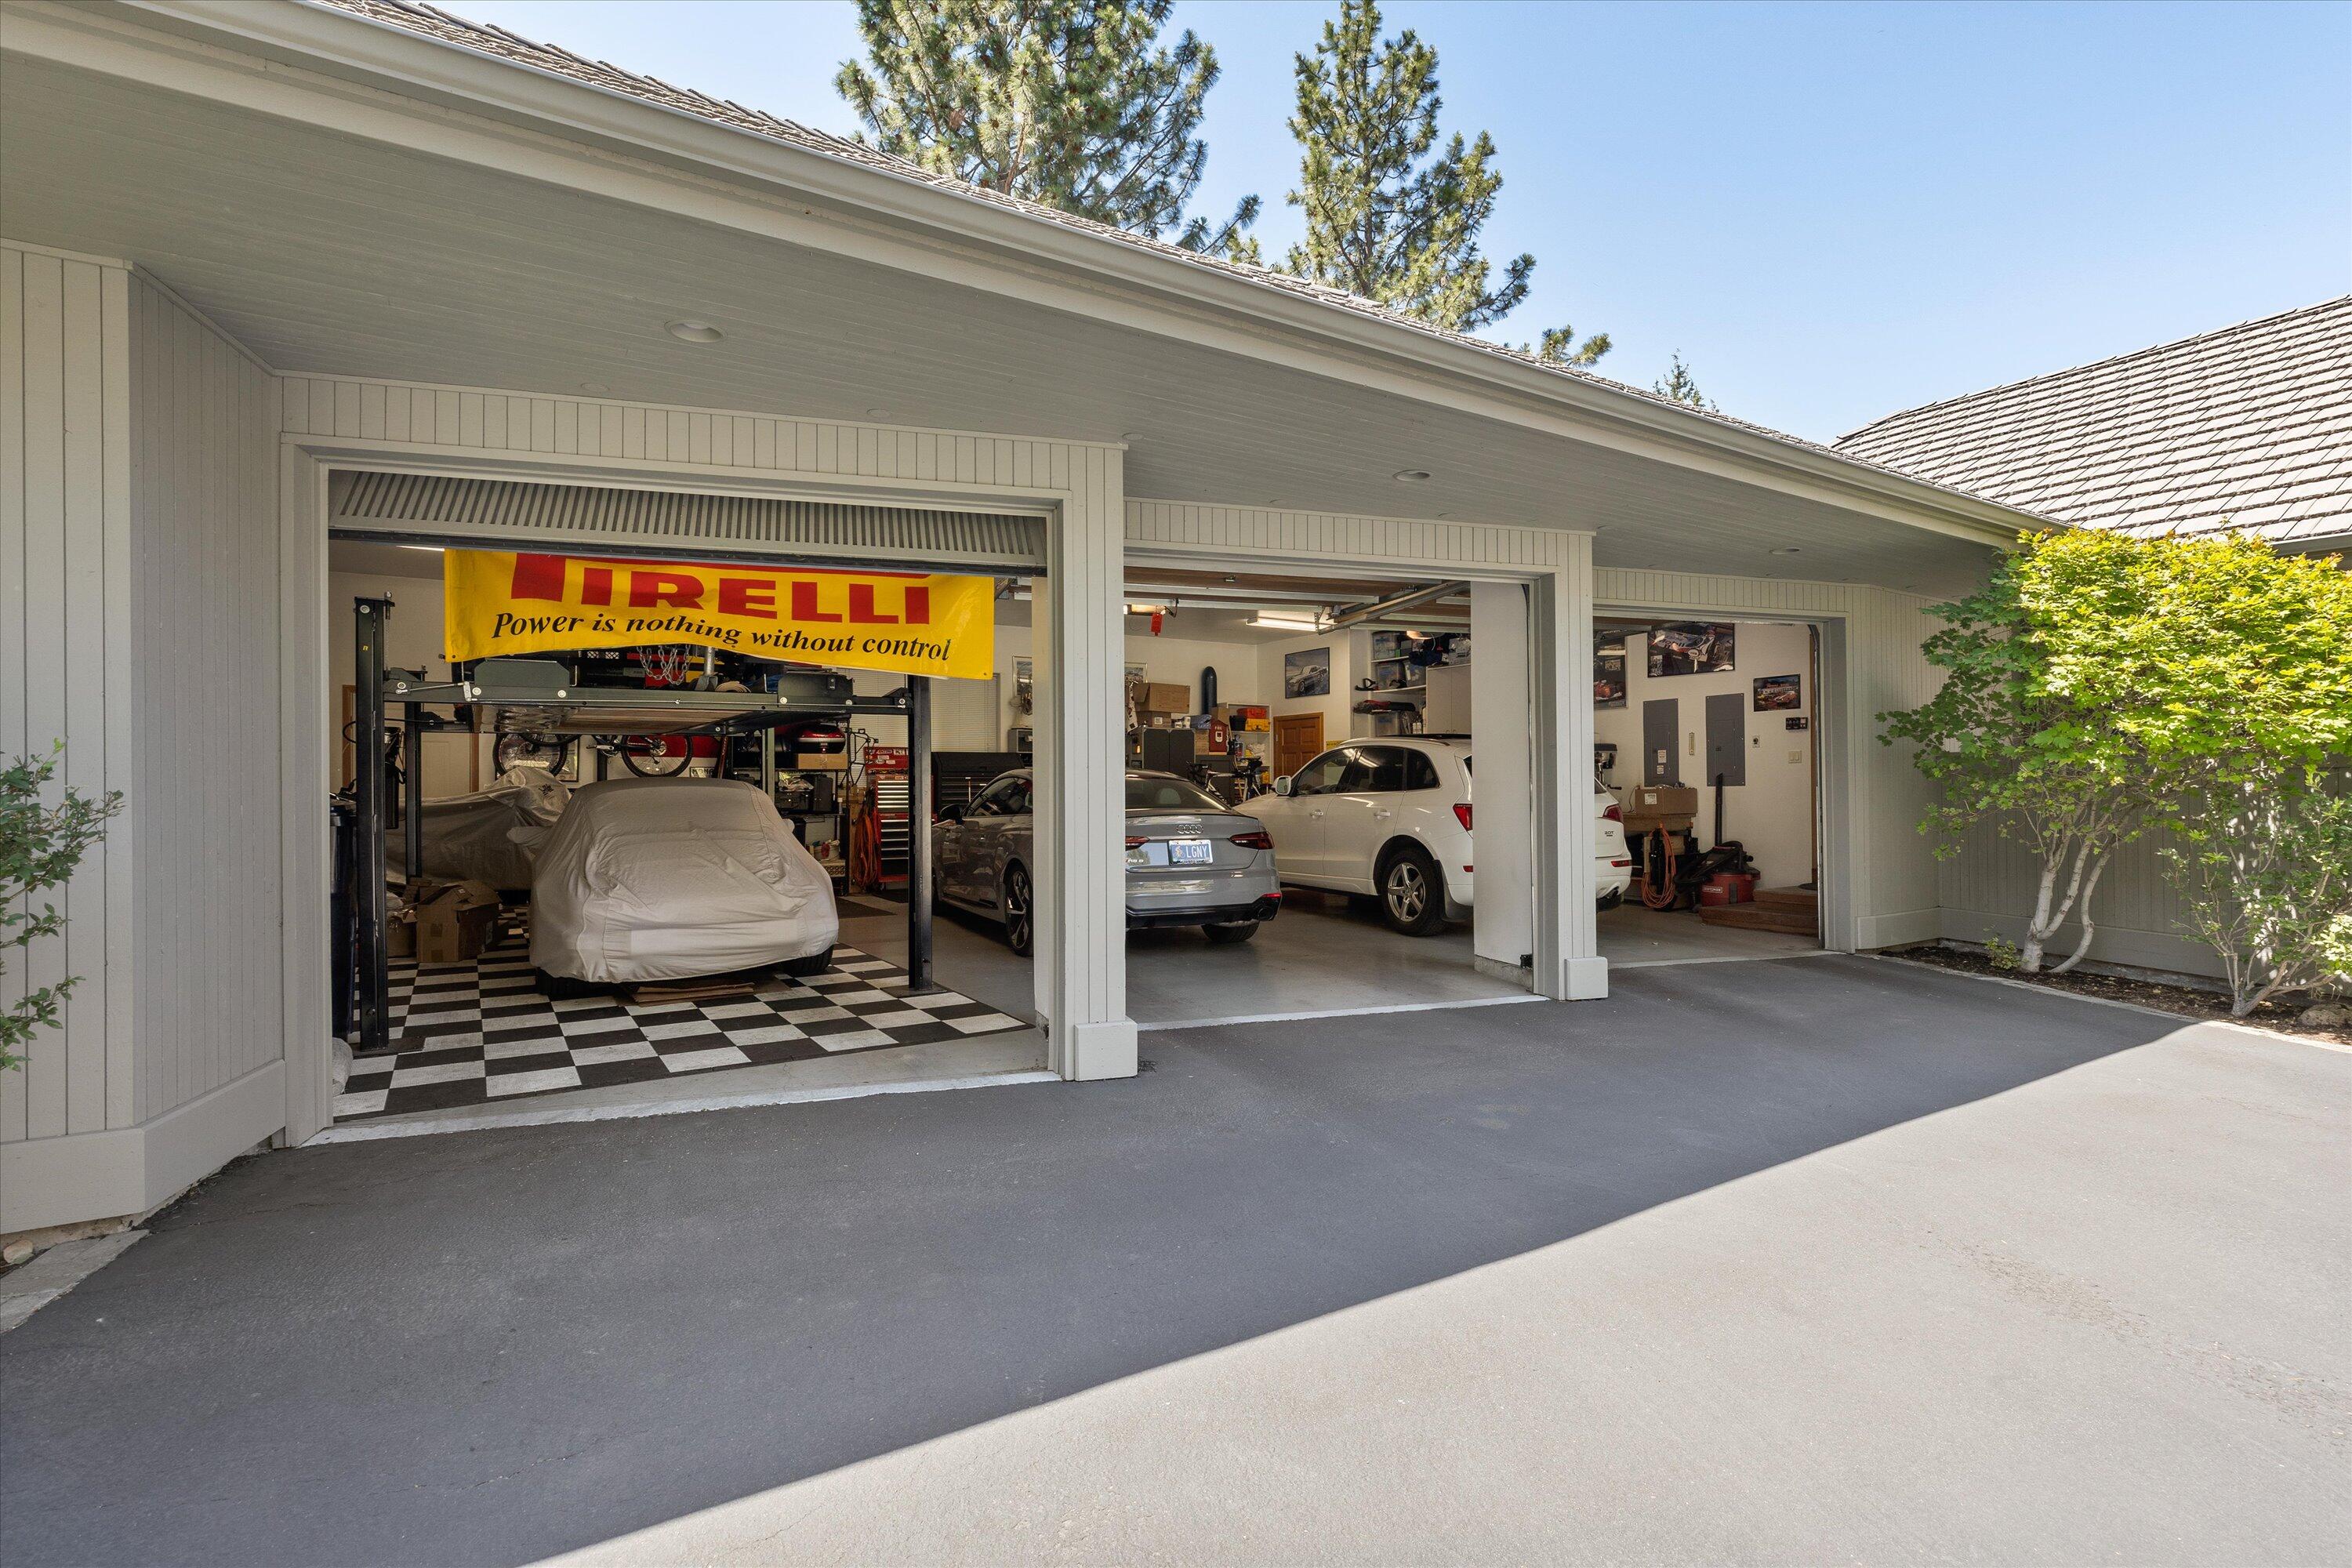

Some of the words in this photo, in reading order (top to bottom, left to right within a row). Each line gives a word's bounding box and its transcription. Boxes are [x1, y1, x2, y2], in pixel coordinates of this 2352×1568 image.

[491, 612, 584, 638] Power
[592, 613, 615, 632] is
[626, 615, 742, 644] nothing
[752, 629, 855, 652] without
[862, 638, 951, 661] control
[1185, 845, 1208, 859] LGNY
